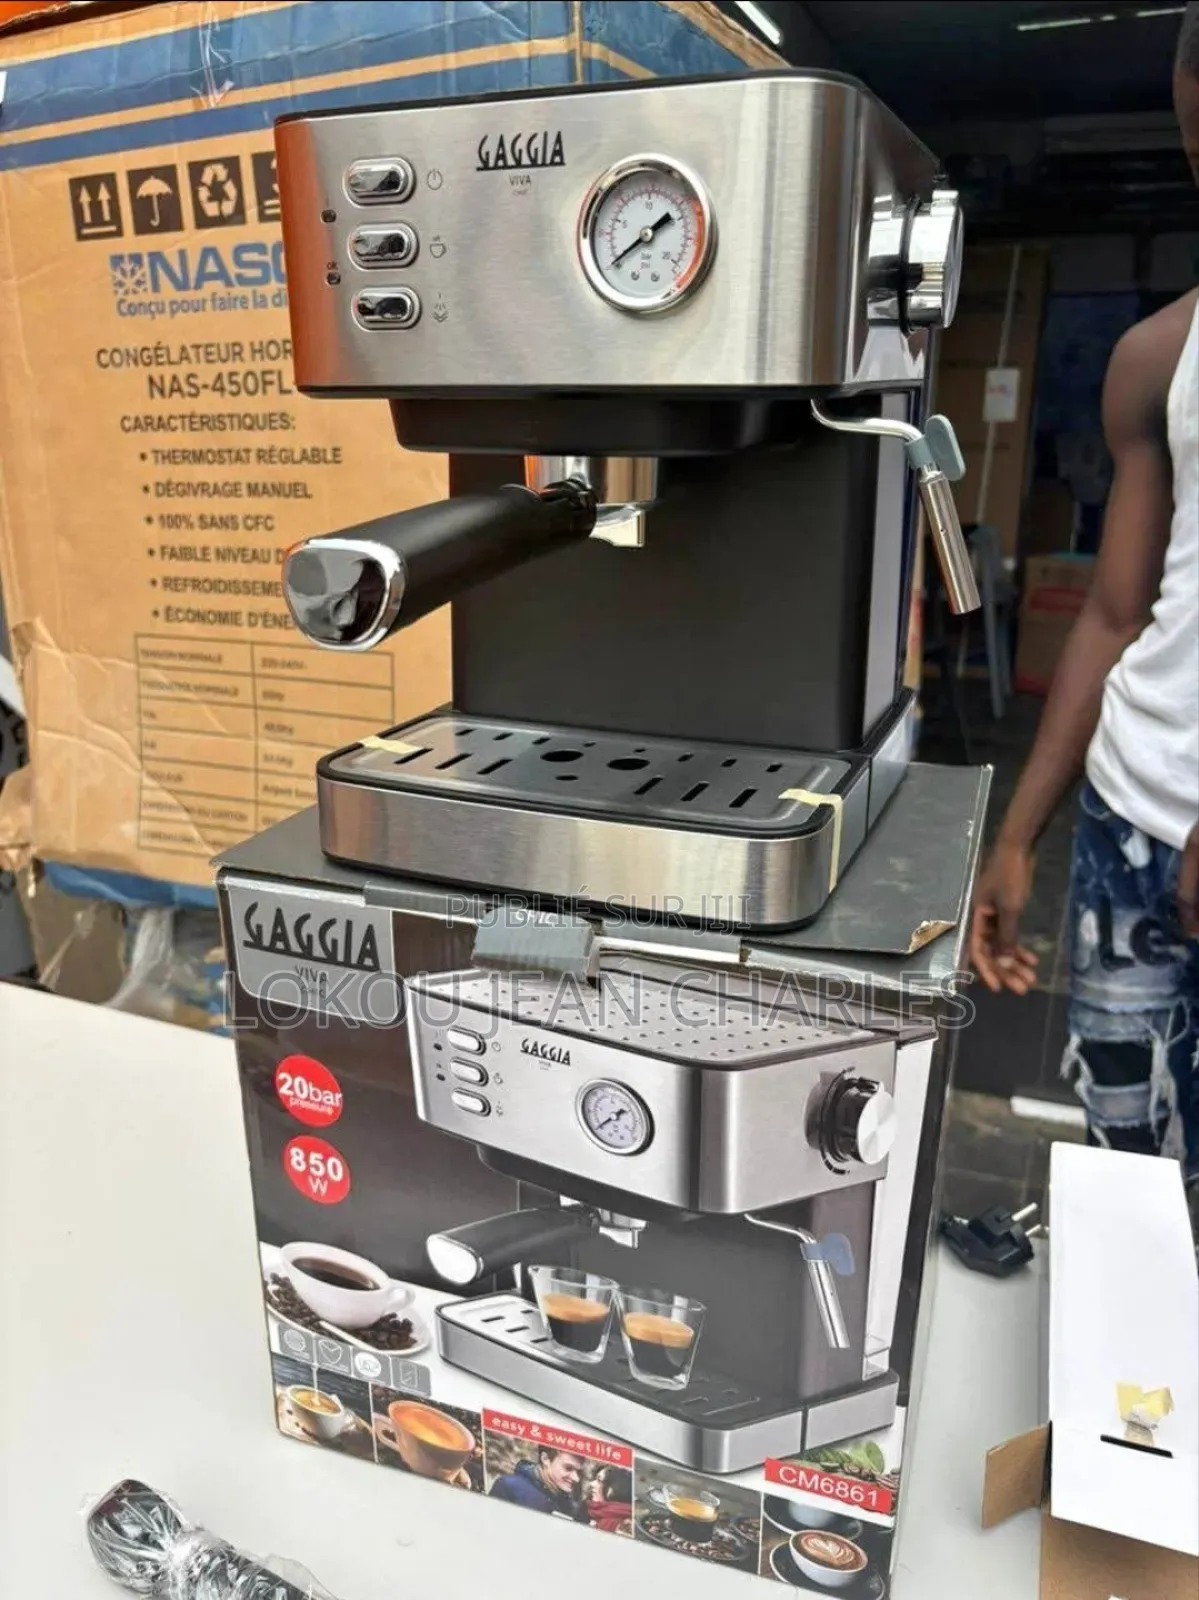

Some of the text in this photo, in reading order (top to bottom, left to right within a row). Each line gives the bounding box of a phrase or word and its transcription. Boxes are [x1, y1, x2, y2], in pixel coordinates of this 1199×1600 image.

[476, 131, 566, 171] GAGGIA
[509, 174, 531, 186] VIVA
[117, 298, 165, 319] Conçu
[169, 299, 206, 317] pour
[211, 291, 249, 312] faire
[252, 289, 268, 308] la
[97, 341, 244, 368] CONGÉLATEUR
[147, 369, 292, 400] NAS-450FL
[120, 411, 295, 433] CARACTÉRISTIQUES:
[152, 446, 342, 466] THERMOSTAT RÉGLABLE
[155, 481, 312, 498] DÉGIVRAGE MANUEL
[158, 514, 275, 531] 100% SANS CFC
[160, 545, 211, 562] FAIBLE
[215, 547, 271, 564] NIVEAU
[165, 605, 242, 627] ÉCONOMIE
[243, 901, 382, 972] GAGGIA
[520, 1038, 571, 1066] GAGGIA
[279, 1072, 342, 1107] 20bar
[290, 1147, 343, 1182] 850
[308, 1175, 328, 1196] W
[492, 1418, 621, 1460] easy & sweet life
[779, 1466, 878, 1506] CM6861
